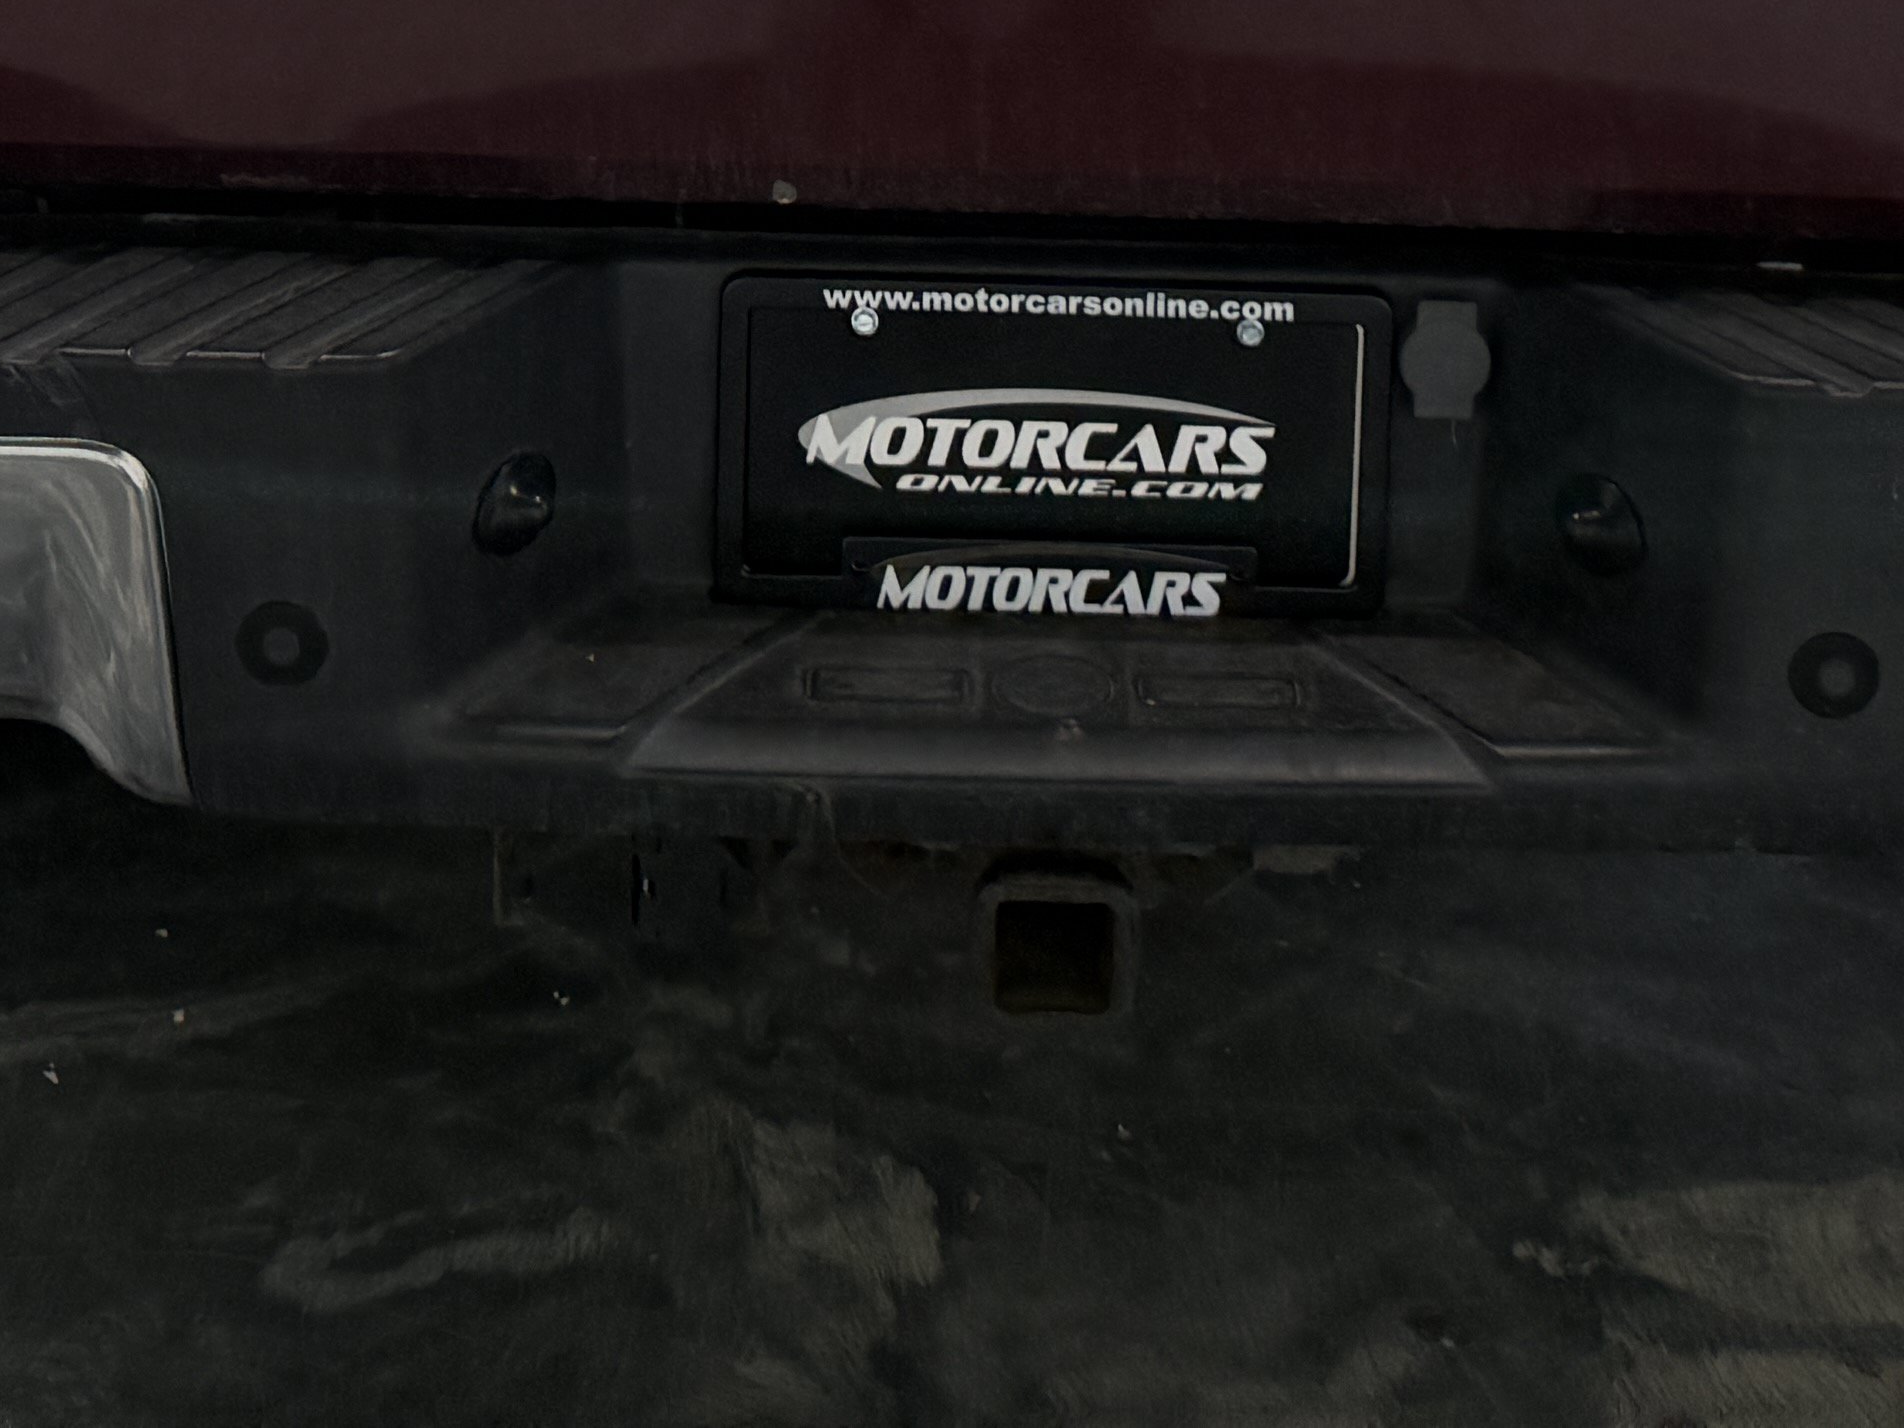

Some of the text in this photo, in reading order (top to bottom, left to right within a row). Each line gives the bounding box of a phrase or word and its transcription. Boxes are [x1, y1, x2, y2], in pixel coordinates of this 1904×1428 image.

[823, 287, 1295, 322] www.motorcarsonline.com
[806, 413, 1276, 476] MOTORCARS
[896, 473, 1264, 501] ONLINE.COM
[876, 564, 1227, 617] MOTORCARS
